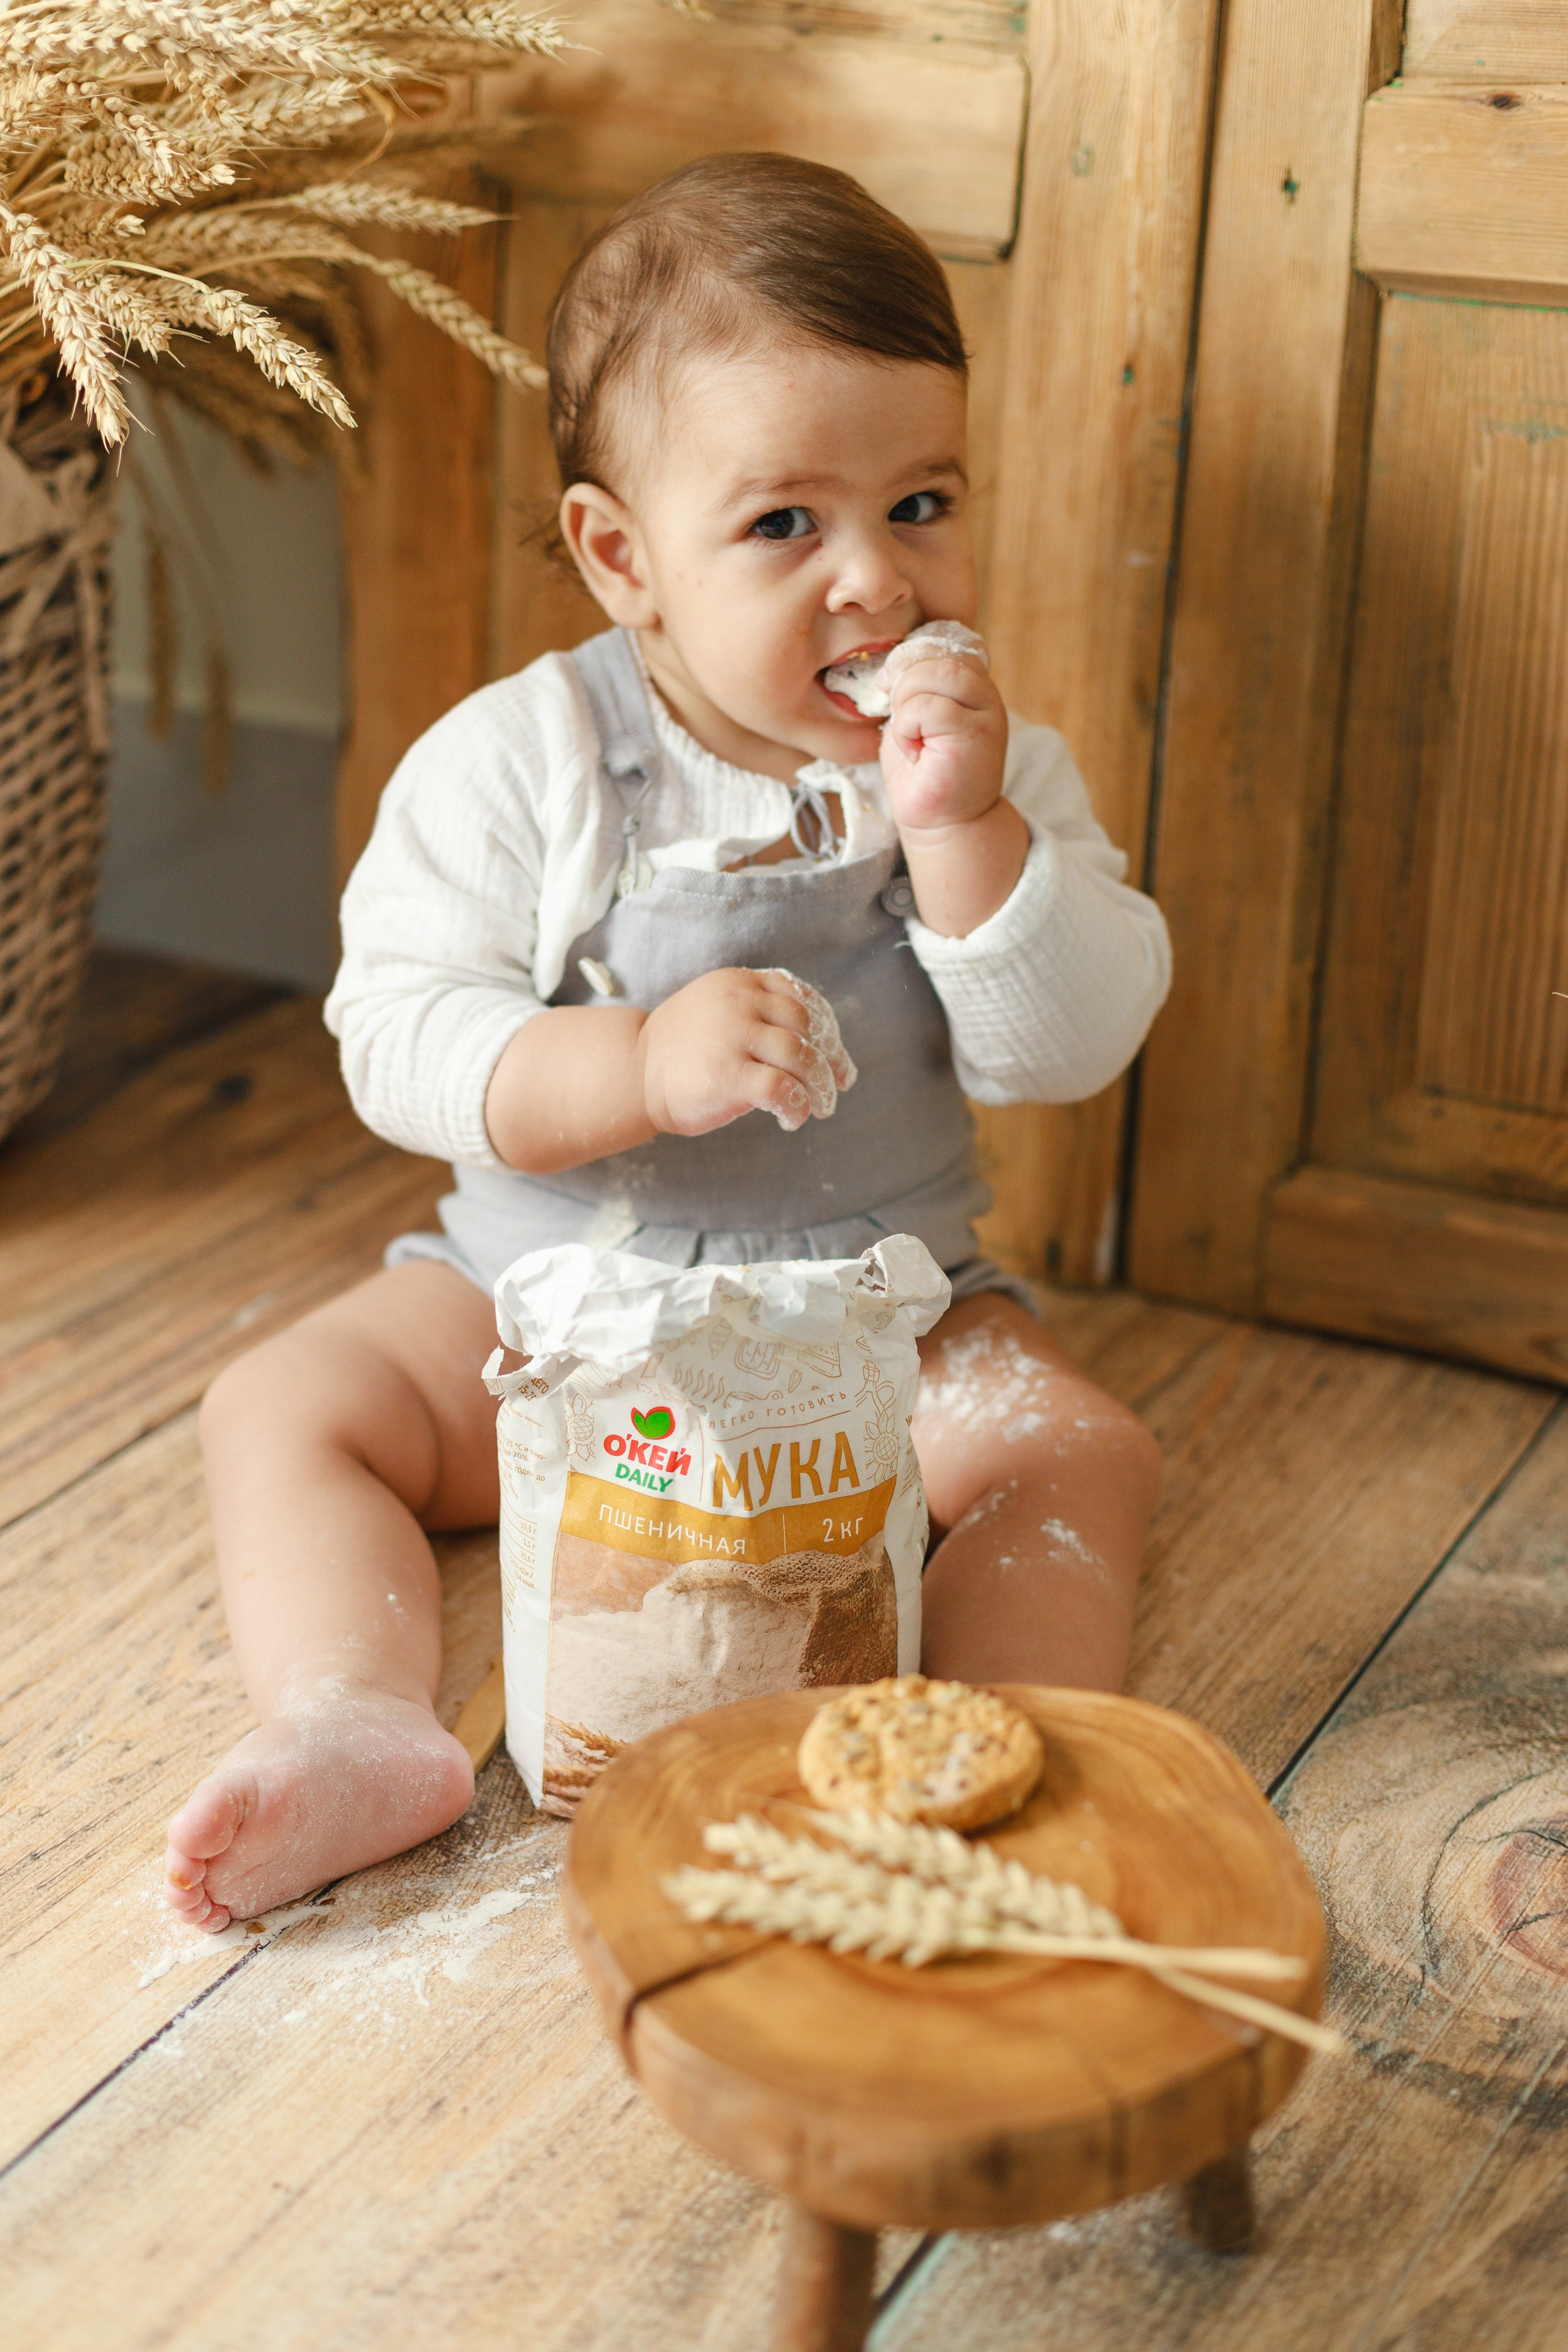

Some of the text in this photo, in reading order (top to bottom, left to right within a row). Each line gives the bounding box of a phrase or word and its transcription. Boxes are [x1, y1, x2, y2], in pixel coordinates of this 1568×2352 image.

[709, 1391, 847, 1430] ЛЕГКО ГОТОВИТЬ
[514, 1466, 533, 1477] годен
[615, 1463, 674, 1493] DAILY
[712, 1431, 861, 1512] МУКА
[598, 1504, 746, 1555] ПШЕНИЧНАЯ
[823, 1516, 864, 1543] 2 кг
